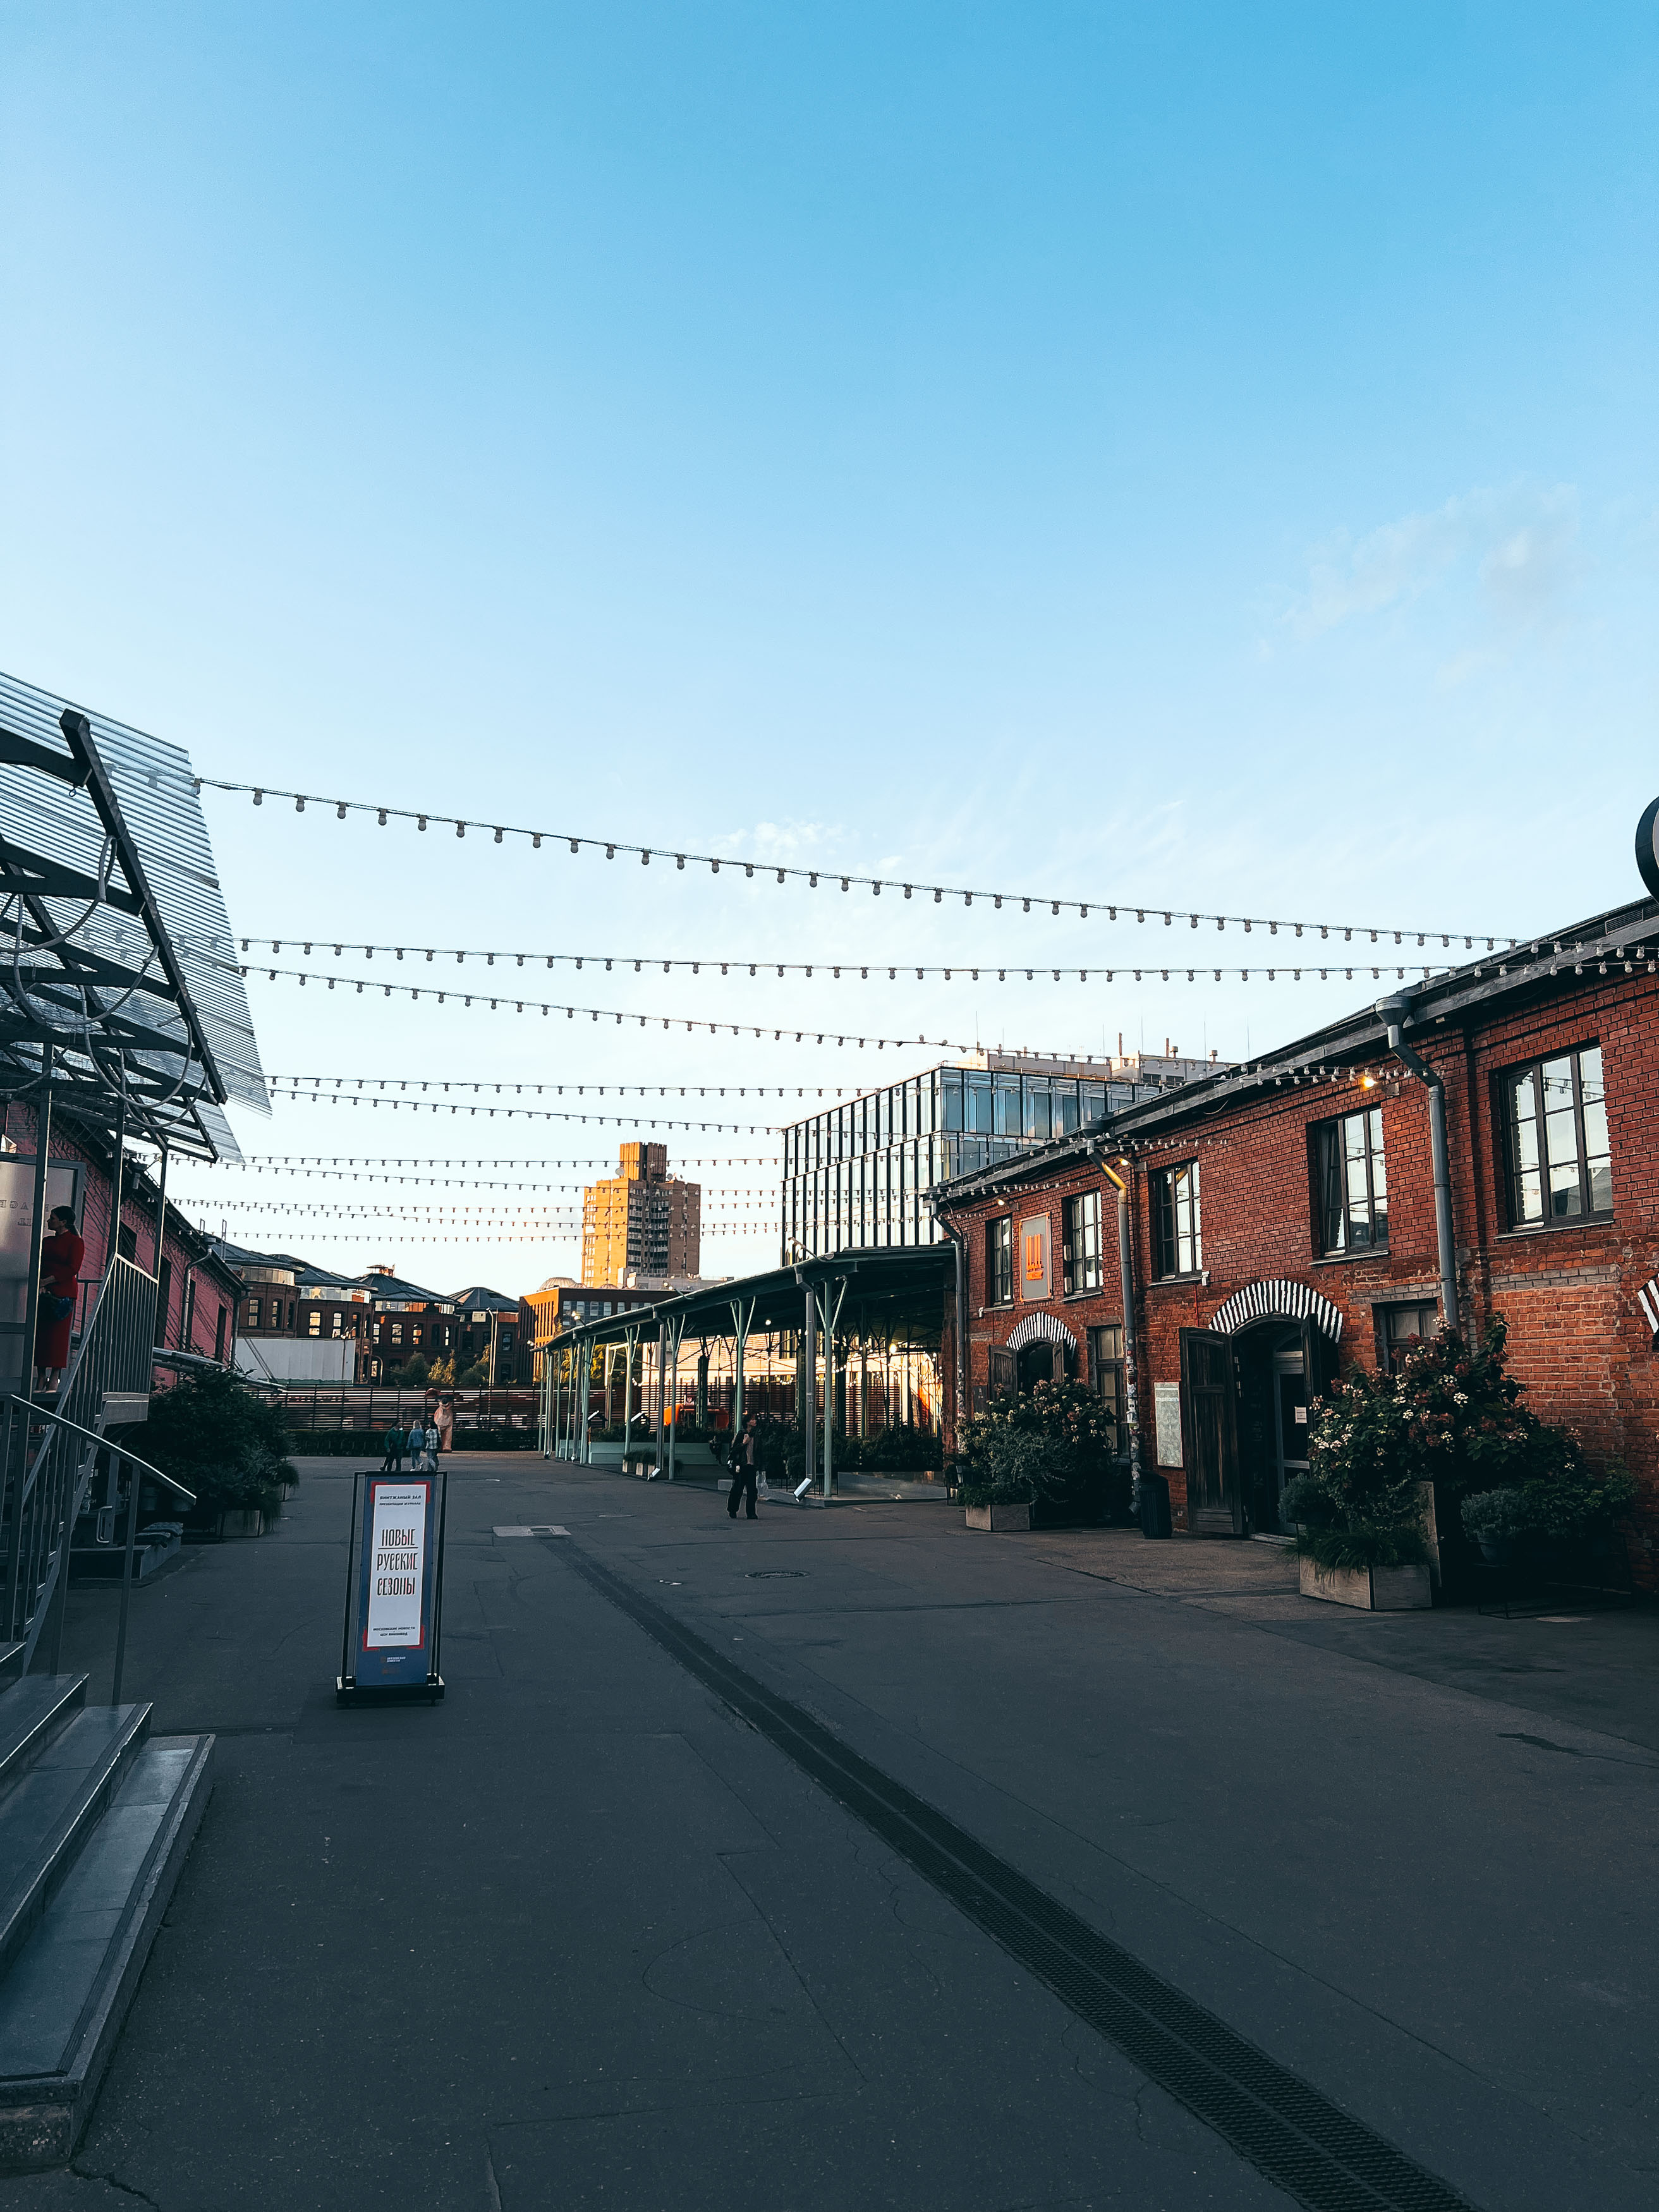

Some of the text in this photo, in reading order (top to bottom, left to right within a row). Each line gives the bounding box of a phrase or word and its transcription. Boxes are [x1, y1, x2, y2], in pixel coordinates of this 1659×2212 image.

[381, 1528, 416, 1547] НОВЫЕ
[376, 1552, 418, 1571] РУССКИЕ
[377, 1577, 415, 1596] СЕЗОНЫ
